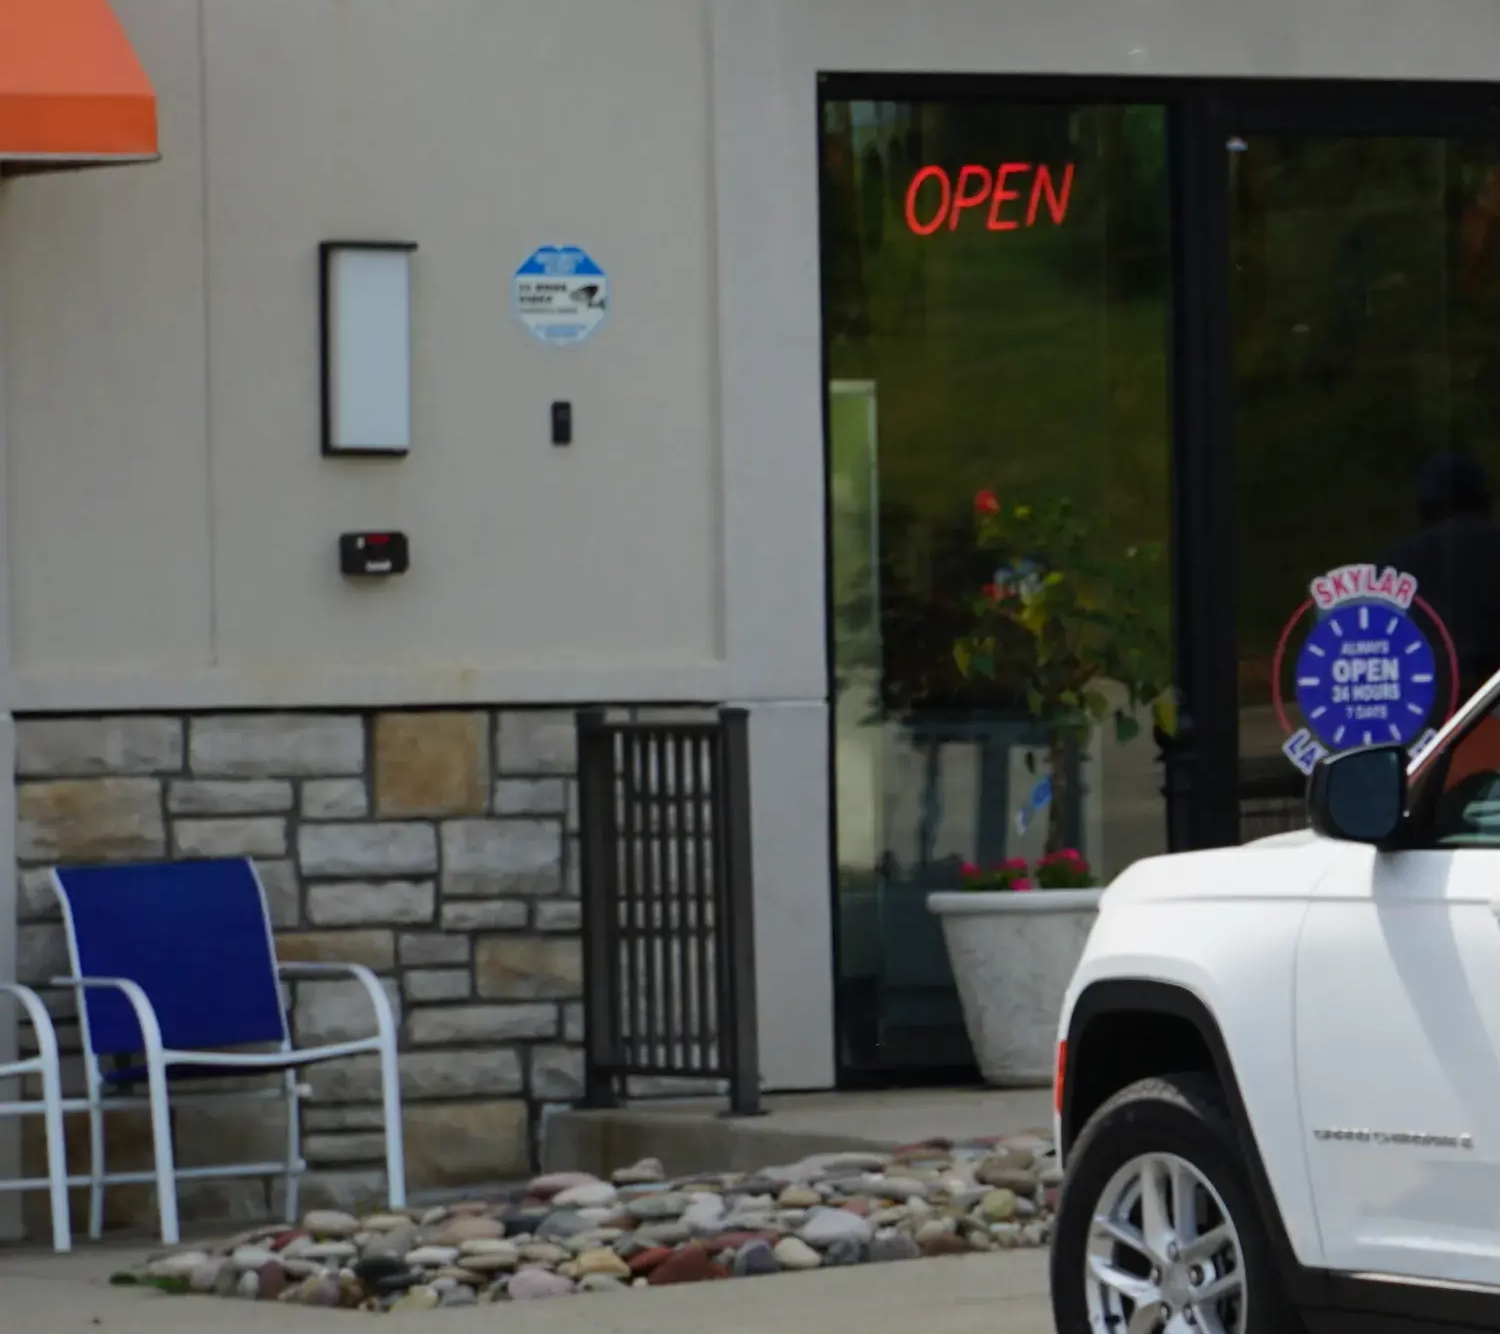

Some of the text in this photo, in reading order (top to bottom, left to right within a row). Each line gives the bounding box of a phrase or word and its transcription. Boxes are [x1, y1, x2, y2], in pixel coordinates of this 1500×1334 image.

[905, 162, 1075, 236] OPEN
[1314, 567, 1415, 605] SKYLAR
[1332, 658, 1400, 683] OPEN
